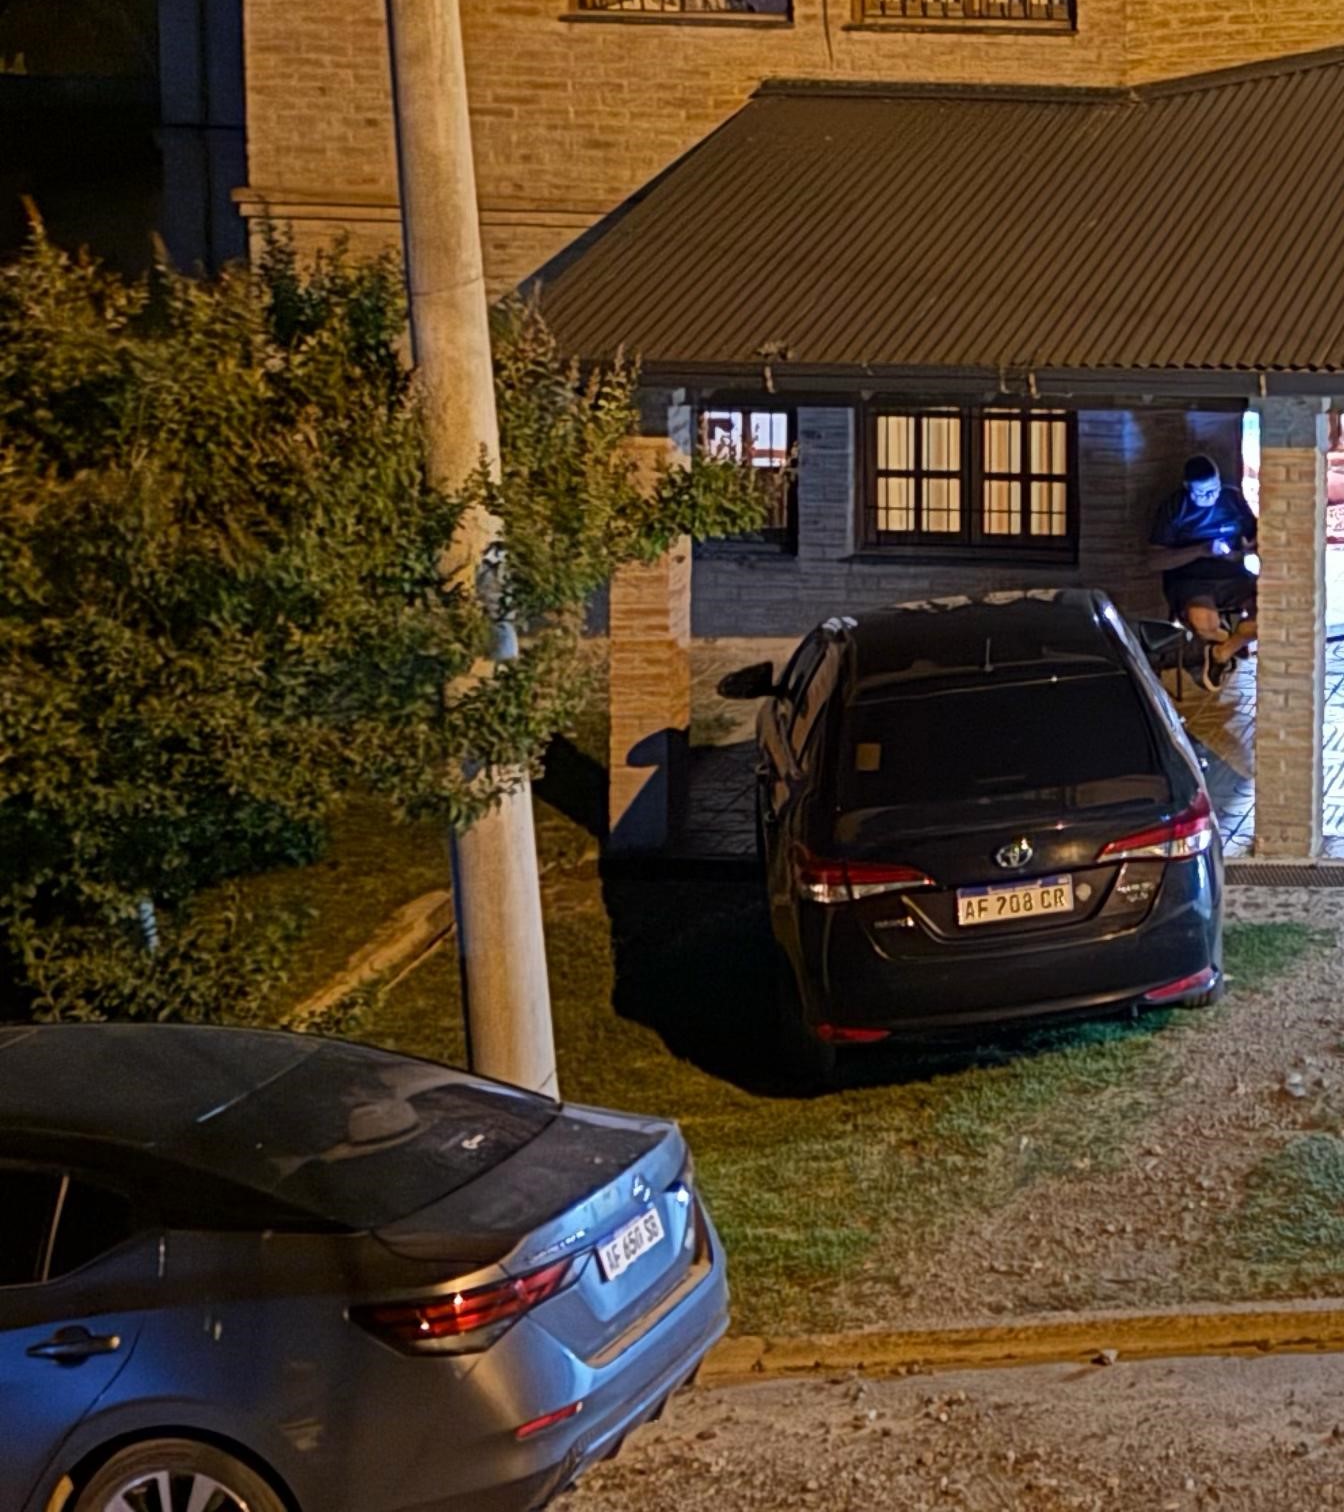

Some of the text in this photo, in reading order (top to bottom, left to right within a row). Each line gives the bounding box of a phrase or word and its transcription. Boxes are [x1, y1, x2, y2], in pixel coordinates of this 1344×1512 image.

[966, 888, 1064, 920] AF 708 CR
